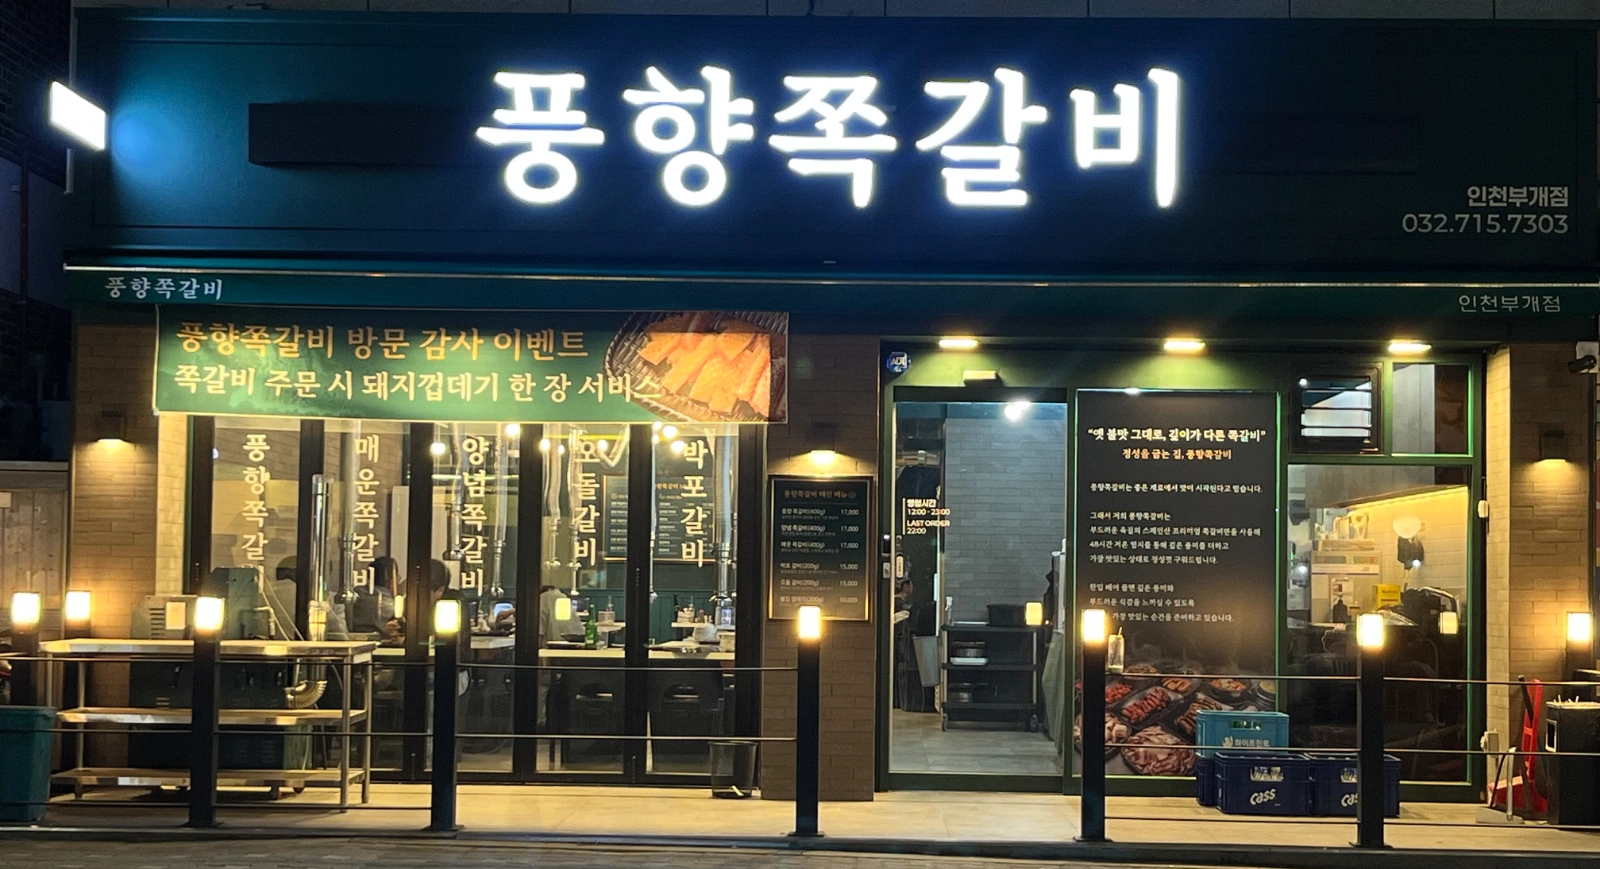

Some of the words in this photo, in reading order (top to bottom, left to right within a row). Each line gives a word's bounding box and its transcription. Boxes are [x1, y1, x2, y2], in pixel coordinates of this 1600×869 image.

[475, 65, 1181, 208] 풍향쪽갈비
[1467, 186, 1569, 208] 인천부개점
[1402, 213, 1568, 234] 032.715.7303
[104, 276, 223, 300] 풍향쪽갈비
[1458, 295, 1561, 313] 인천부개점
[176, 322, 334, 359] 풍향쪽갈비
[347, 326, 411, 361] 방문
[419, 328, 485, 361] 감사
[493, 328, 589, 361] 이벤트
[174, 364, 256, 396] 쪽갈비
[265, 370, 321, 398] 주문
[328, 370, 353, 400] 시
[361, 371, 499, 402] 돼지껍데기
[508, 373, 537, 402] 한
[543, 373, 572, 403] 장
[578, 373, 663, 403] 서비스
[1107, 428, 1129, 442] 불맛
[1130, 428, 1166, 442] 그대로,
[1169, 428, 1201, 442] 깊이가
[1204, 428, 1226, 442] 다른
[1122, 449, 1150, 460] 정성을
[1152, 449, 1170, 460] 굽는
[1173, 449, 1185, 460] 집,
[1186, 449, 1232, 460] 풍향쪽갈비
[573, 439, 601, 567] 오돌갈비
[680, 439, 709, 568] 박포갈비
[840, 508, 860, 516] 17,000
[907, 499, 937, 508] 영업시간
[907, 508, 926, 516] 12:00
[930, 508, 950, 516] 23:00
[353, 434, 380, 595] 매운쪽갈비
[461, 436, 489, 597] 양념쪽갈비
[1234, 739, 1270, 747] 하이트진로
